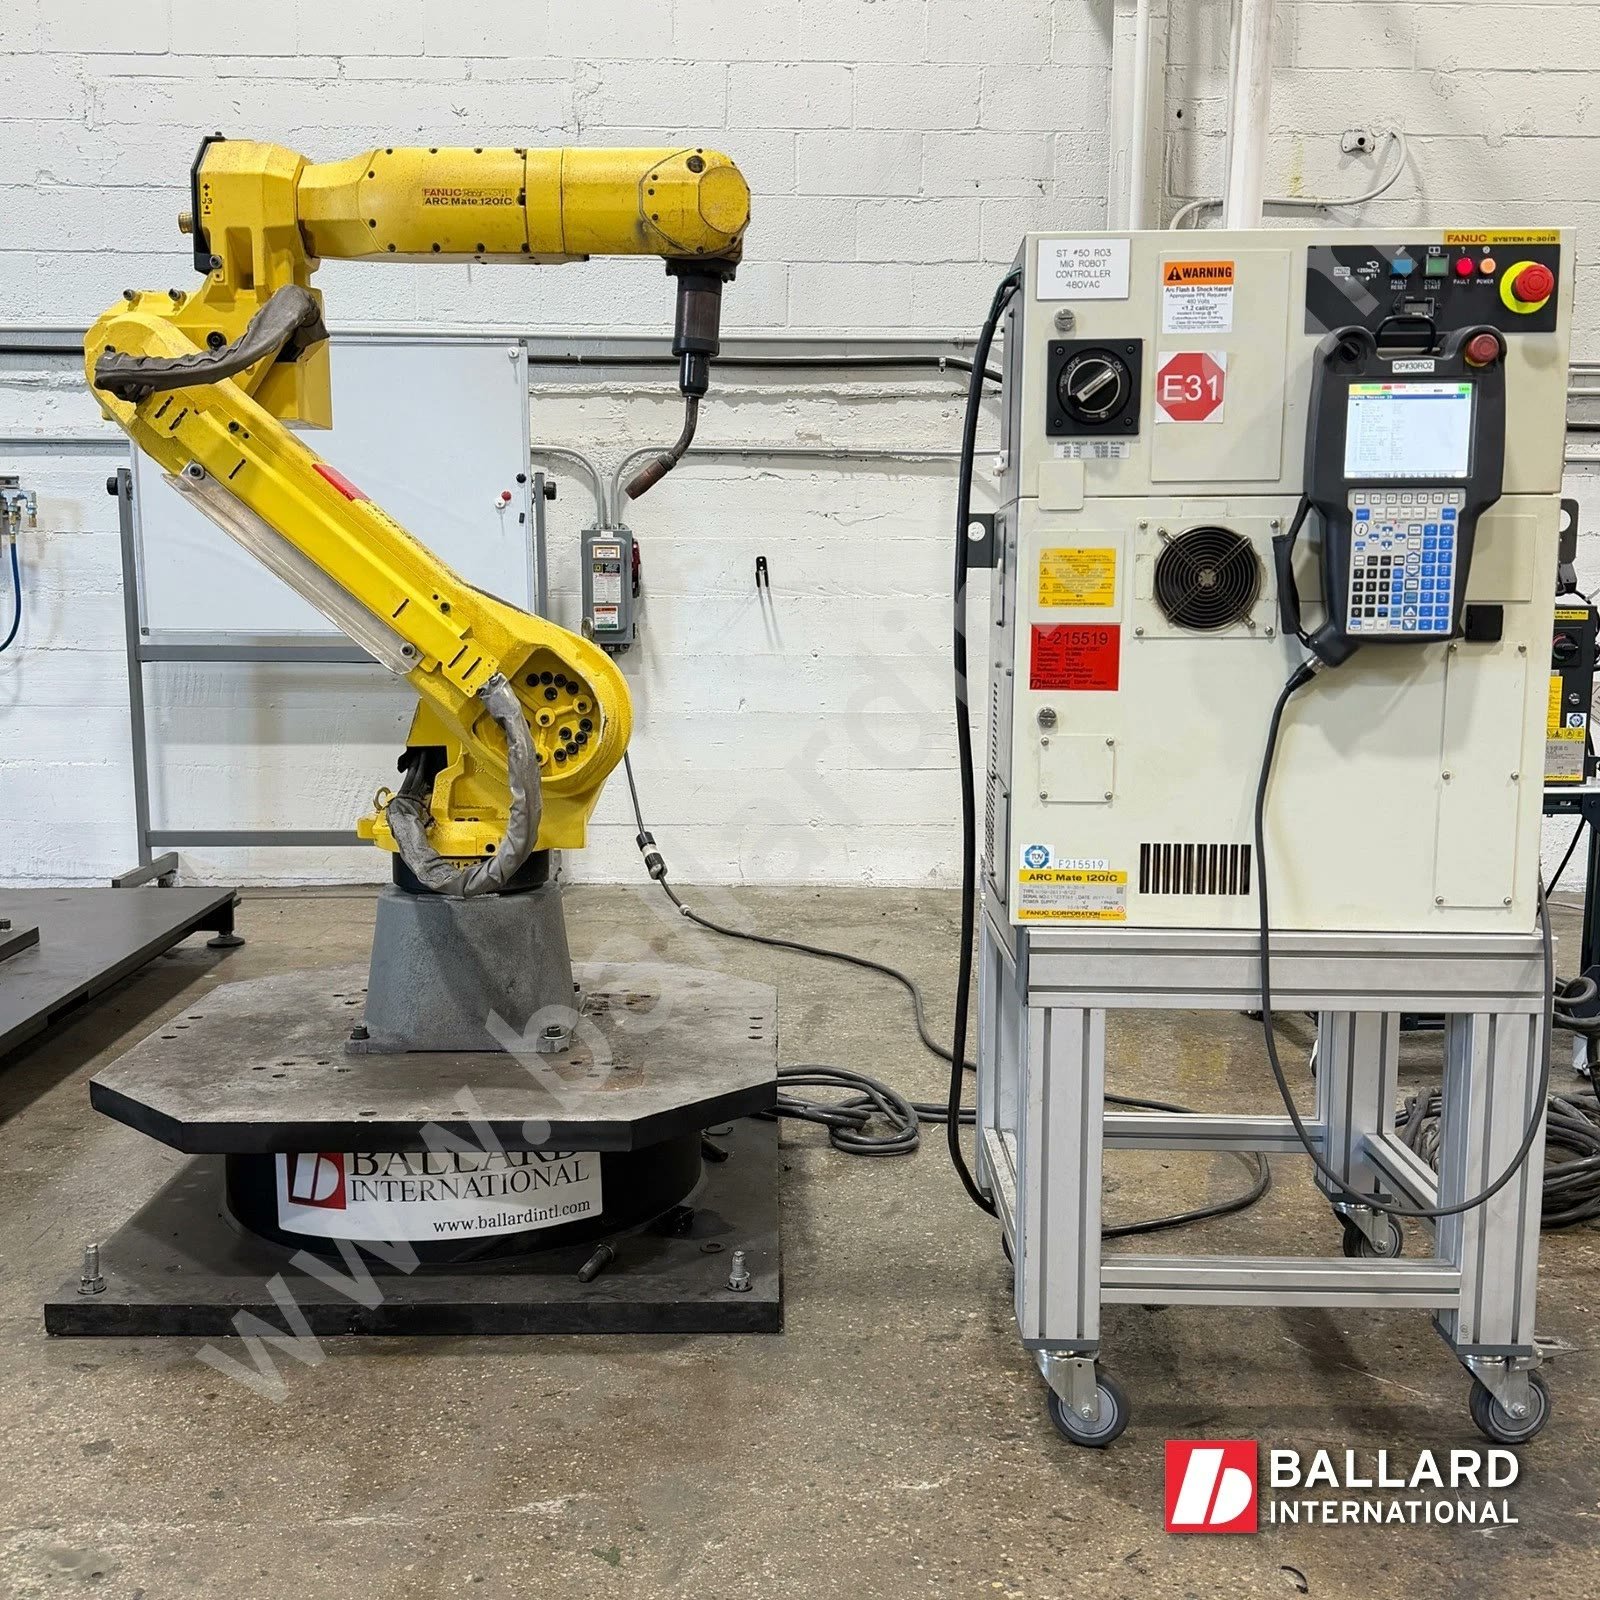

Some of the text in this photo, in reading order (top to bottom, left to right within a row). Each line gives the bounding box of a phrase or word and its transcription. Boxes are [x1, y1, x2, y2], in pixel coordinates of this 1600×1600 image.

[424, 188, 462, 197] FANUC
[425, 197, 449, 205] ARC
[451, 197, 478, 205] Mate
[1447, 234, 1488, 243] FANUC
[1056, 249, 1068, 258] ST
[1060, 259, 1107, 268] MIG ROBOT
[1055, 269, 1111, 279] CONTROLLER
[1182, 266, 1232, 278] WARNING
[1065, 280, 1101, 289] 480VAC
[1163, 374, 1219, 402] E31
[1058, 859, 1104, 869] F215519
[1028, 872, 1118, 882] ARC Mate 120iC
[351, 1160, 590, 1203] INTERNATIONAL
[433, 1199, 591, 1233] www.ballardintl.com
